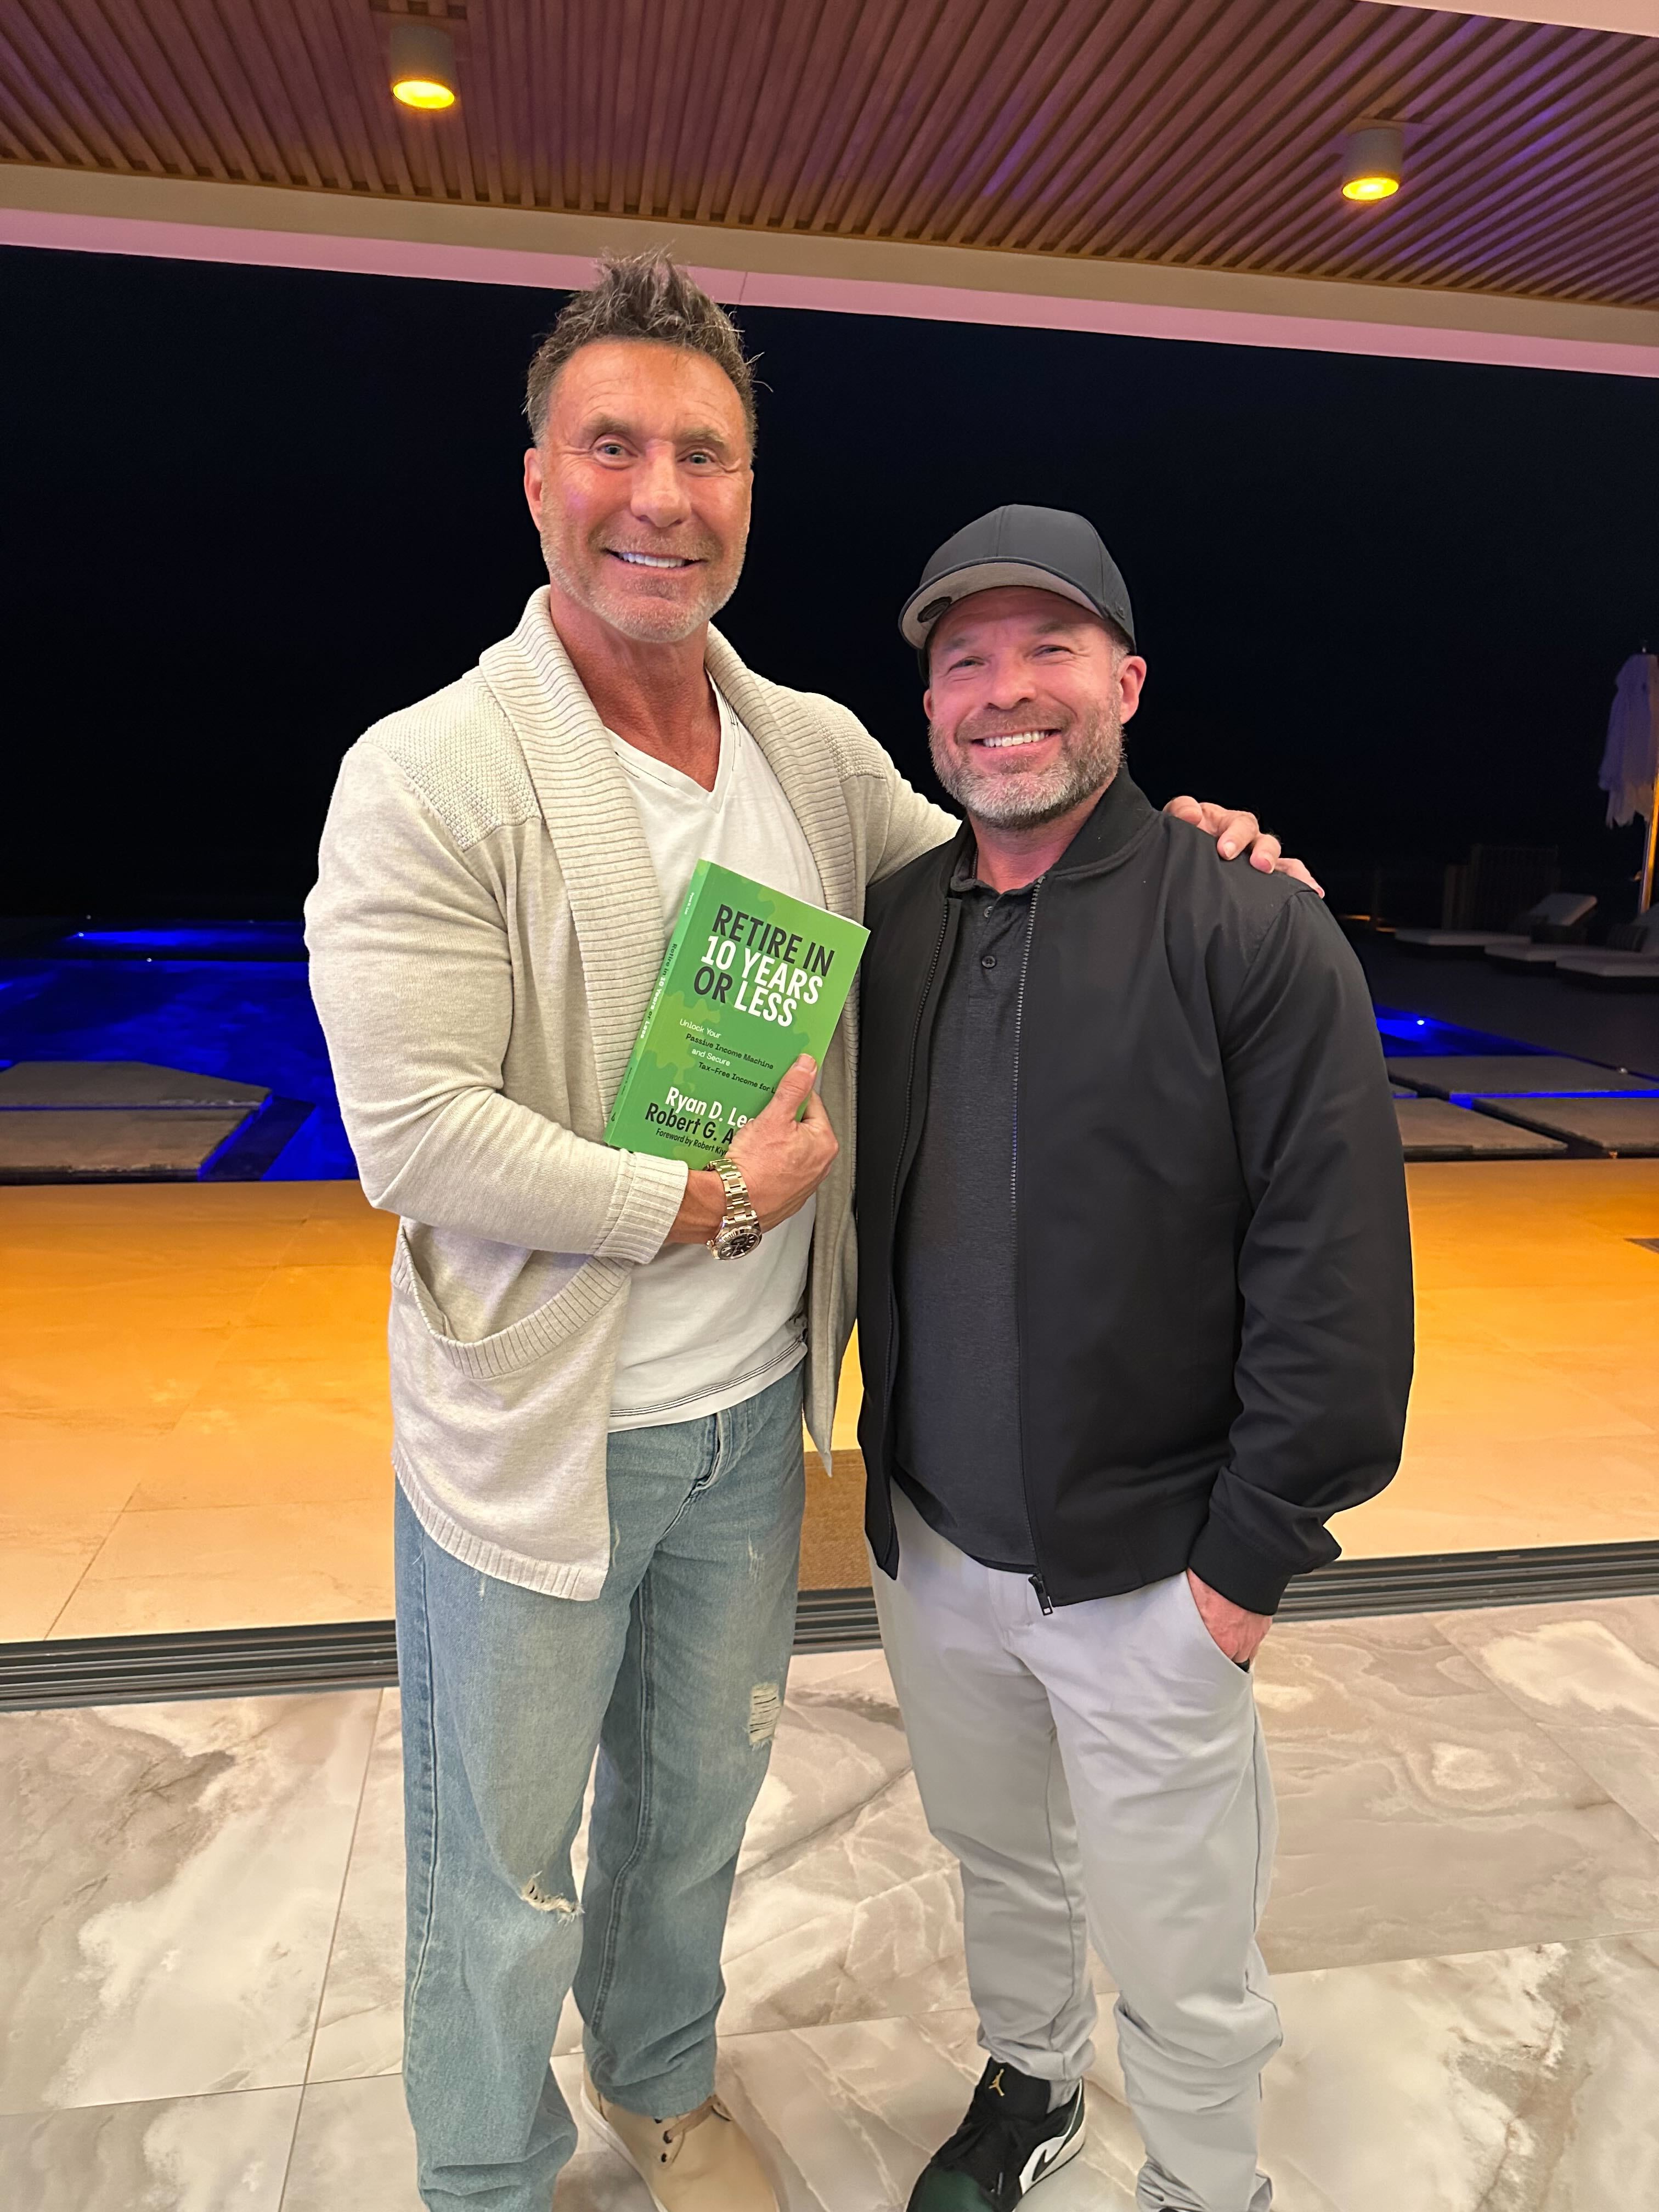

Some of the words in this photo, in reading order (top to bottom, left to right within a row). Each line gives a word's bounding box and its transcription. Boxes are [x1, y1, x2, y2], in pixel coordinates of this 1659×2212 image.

[665, 943, 678, 967] Retire
[712, 904, 803, 964] RETIRE
[803, 942, 835, 977] IN
[659, 977, 665, 987] 10
[701, 935, 736, 970] 10
[742, 947, 823, 1005] YEARS
[694, 966, 733, 1004] OR
[734, 980, 797, 1027] LESS
[680, 1018, 704, 1032] Unlock
[707, 1028, 722, 1039] Your
[686, 1033, 713, 1048] Passive
[715, 1043, 742, 1058] Income
[743, 1054, 774, 1069] Machine
[692, 1048, 706, 1058] and
[707, 1053, 730, 1066] Secure
[698, 1062, 730, 1078] Tax-Free
[731, 1073, 758, 1087] Income
[759, 1083, 770, 1091] for
[665, 1086, 707, 1116] Ryan
[708, 1101, 723, 1122] D.
[645, 1102, 701, 1135] Robert
[703, 1121, 717, 1141] G.
[721, 1128, 735, 1144] A
[656, 1128, 685, 1143] Foreword
[685, 1136, 692, 1147] by
[693, 1141, 714, 1152] Robert
